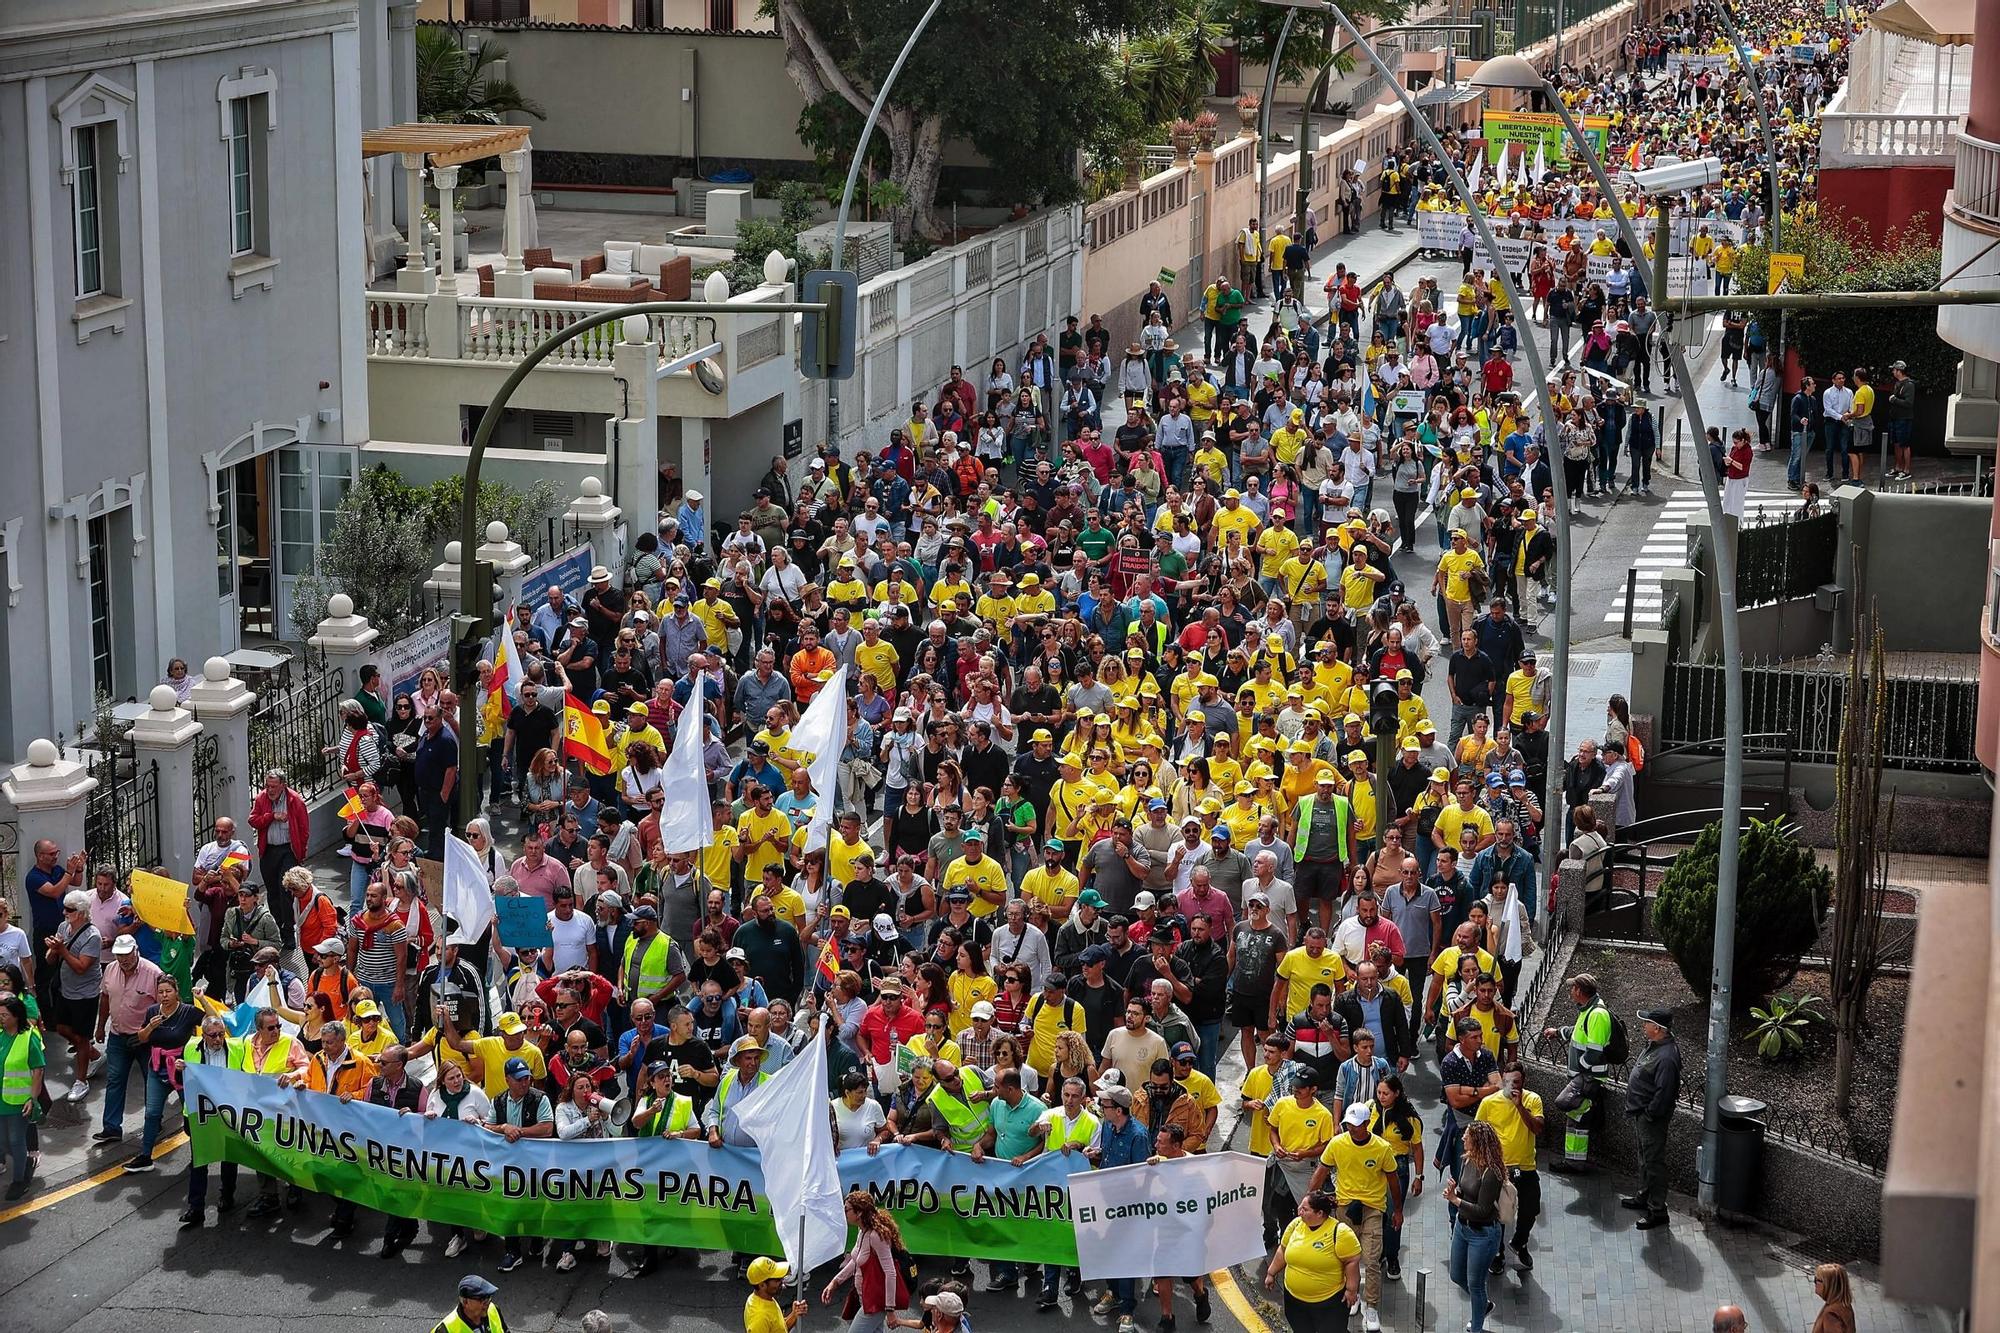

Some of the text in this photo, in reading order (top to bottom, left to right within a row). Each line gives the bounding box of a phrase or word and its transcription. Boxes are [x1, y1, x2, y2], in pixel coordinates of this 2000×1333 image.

[1509, 131, 1542, 139] NUESTRO
[1502, 245, 1522, 253] espejo
[196, 1093, 265, 1145] POR
[273, 1111, 360, 1164] UNAS
[366, 1138, 493, 1194] RENTAS
[502, 1164, 646, 1201] DIGNAS
[657, 1170, 758, 1215] PARA
[949, 1183, 1074, 1222] CANARI
[1078, 1182, 1258, 1224] El campo se planta
